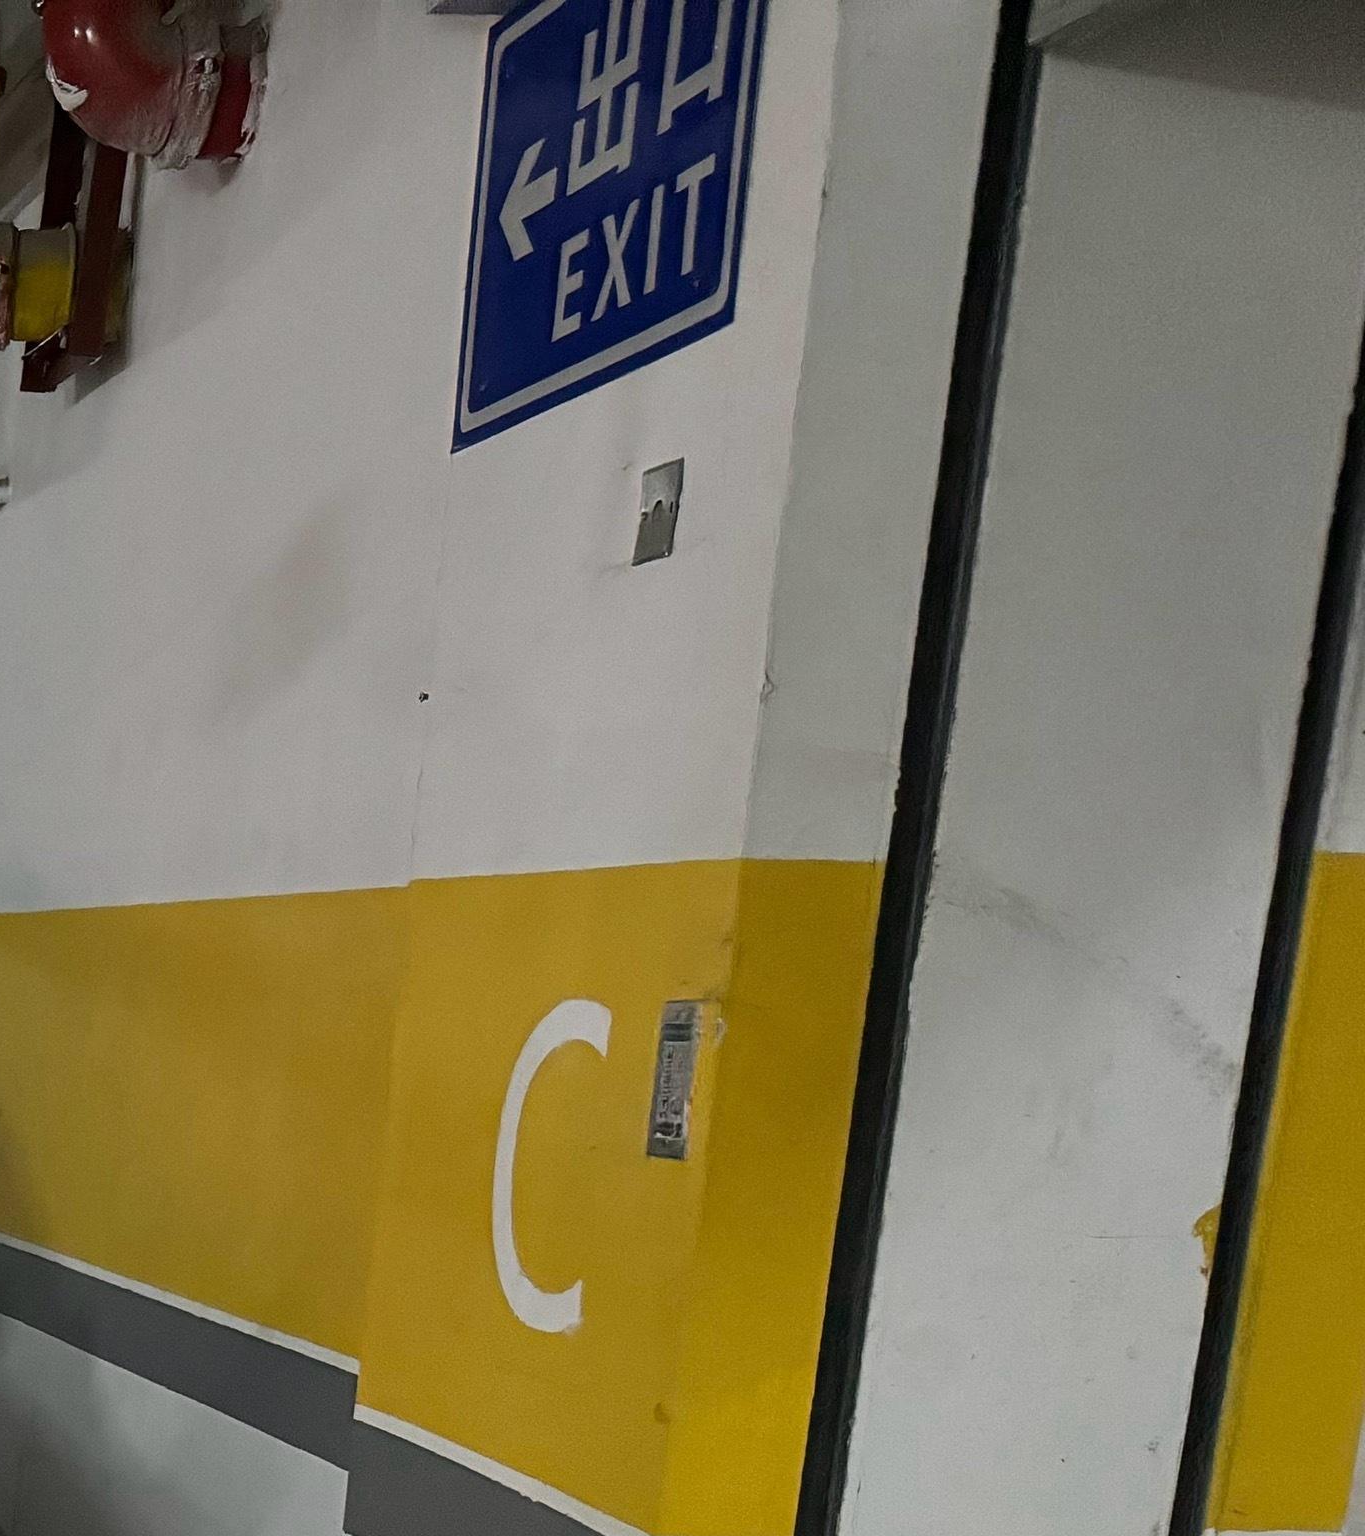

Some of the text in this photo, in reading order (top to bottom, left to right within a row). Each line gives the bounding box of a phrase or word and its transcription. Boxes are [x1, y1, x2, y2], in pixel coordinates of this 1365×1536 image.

[566, 0, 731, 197] 出口
[551, 153, 716, 343] EXIT
[492, 999, 612, 1334] C
